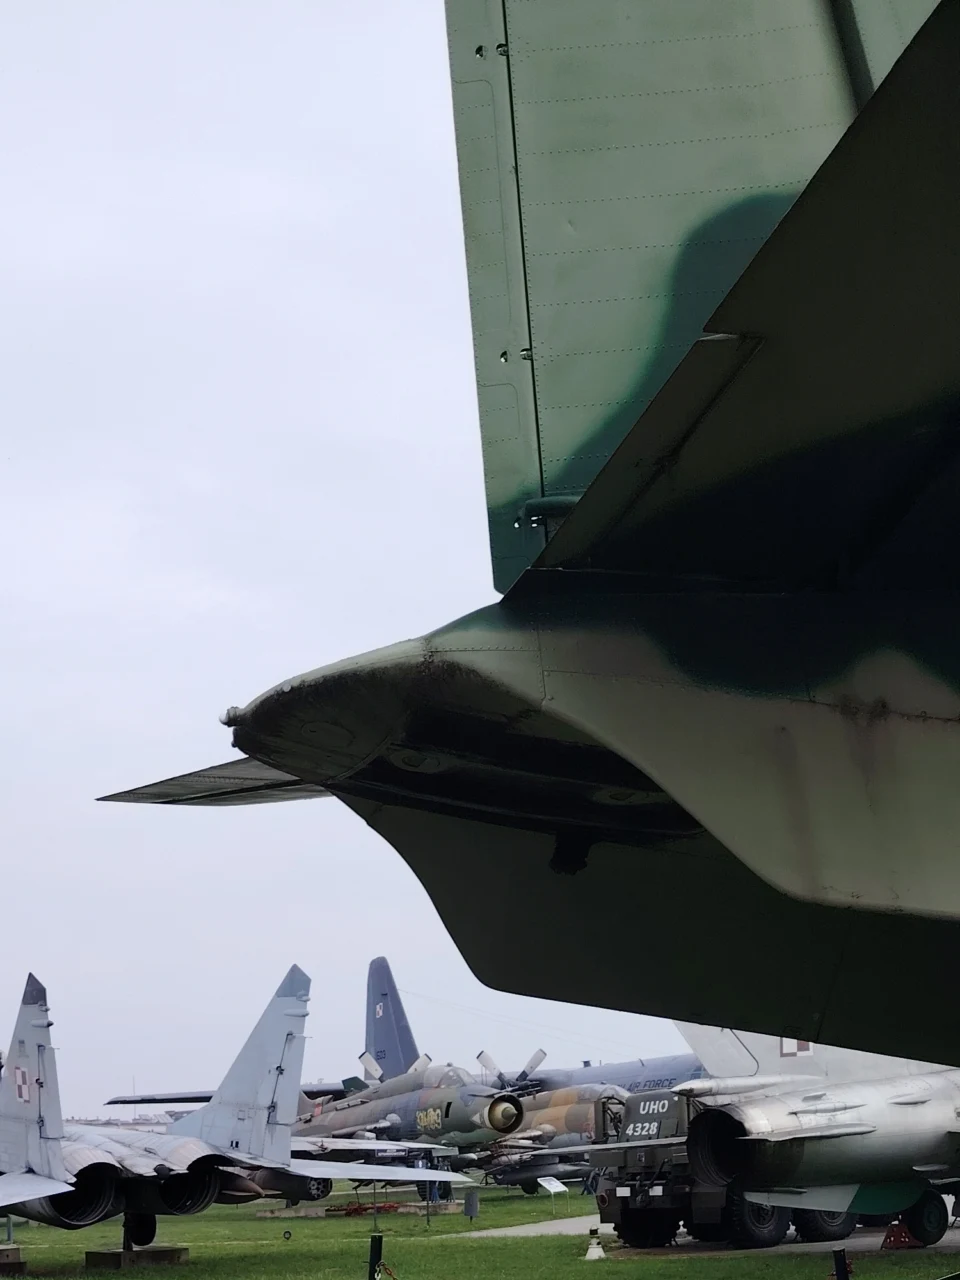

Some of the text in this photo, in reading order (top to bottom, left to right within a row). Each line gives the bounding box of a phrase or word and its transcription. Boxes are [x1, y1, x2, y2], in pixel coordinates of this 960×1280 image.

[643, 1078, 677, 1089] FORCE
[640, 1100, 669, 1114] UHO
[625, 1122, 658, 1136] 4328
